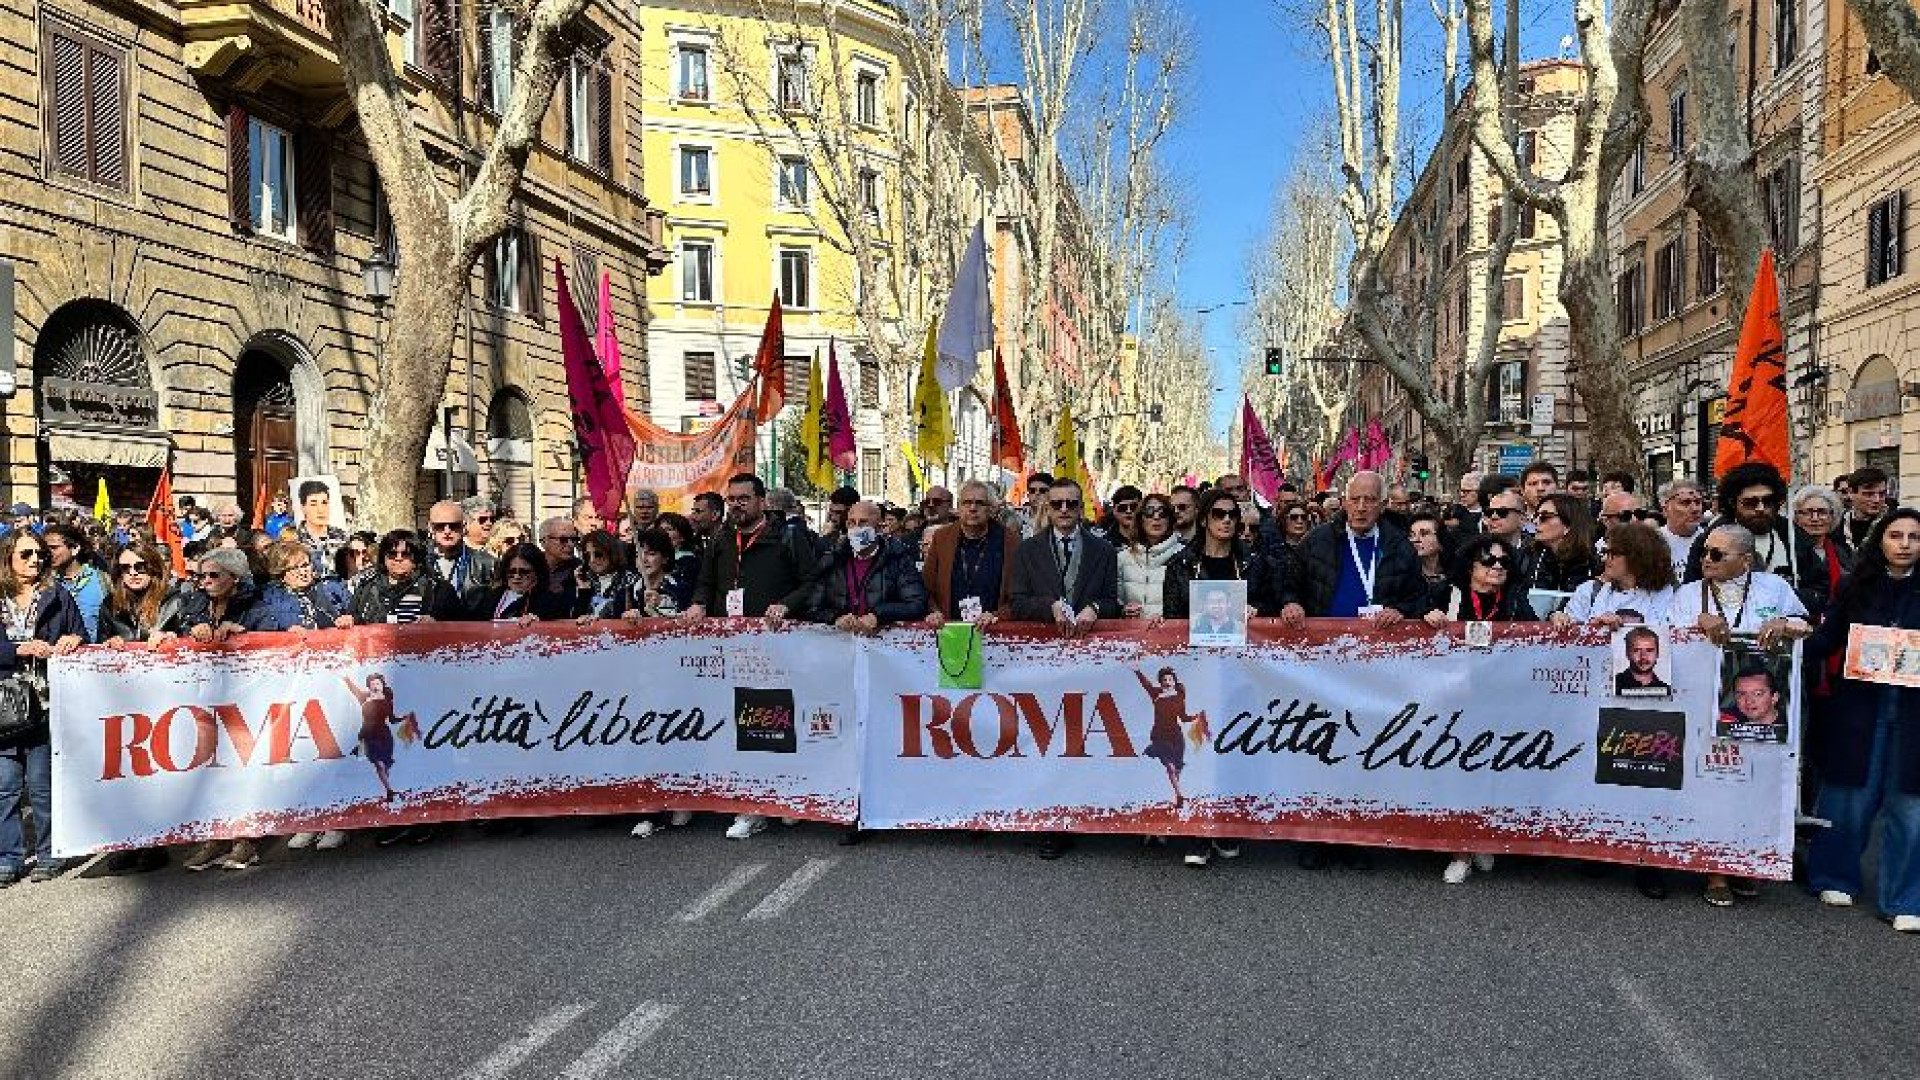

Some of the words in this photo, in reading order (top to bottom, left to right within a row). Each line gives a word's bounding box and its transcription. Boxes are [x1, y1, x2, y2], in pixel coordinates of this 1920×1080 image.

[1576, 655, 1591, 669] 21
[1531, 667, 1591, 682] marzo
[1549, 681, 1590, 698] 2024
[96, 698, 347, 782] ROMA
[423, 694, 550, 750] città
[548, 690, 727, 751] libera
[895, 691, 1139, 760] ROMA
[1213, 698, 1361, 766] città
[1356, 702, 1585, 772] libera
